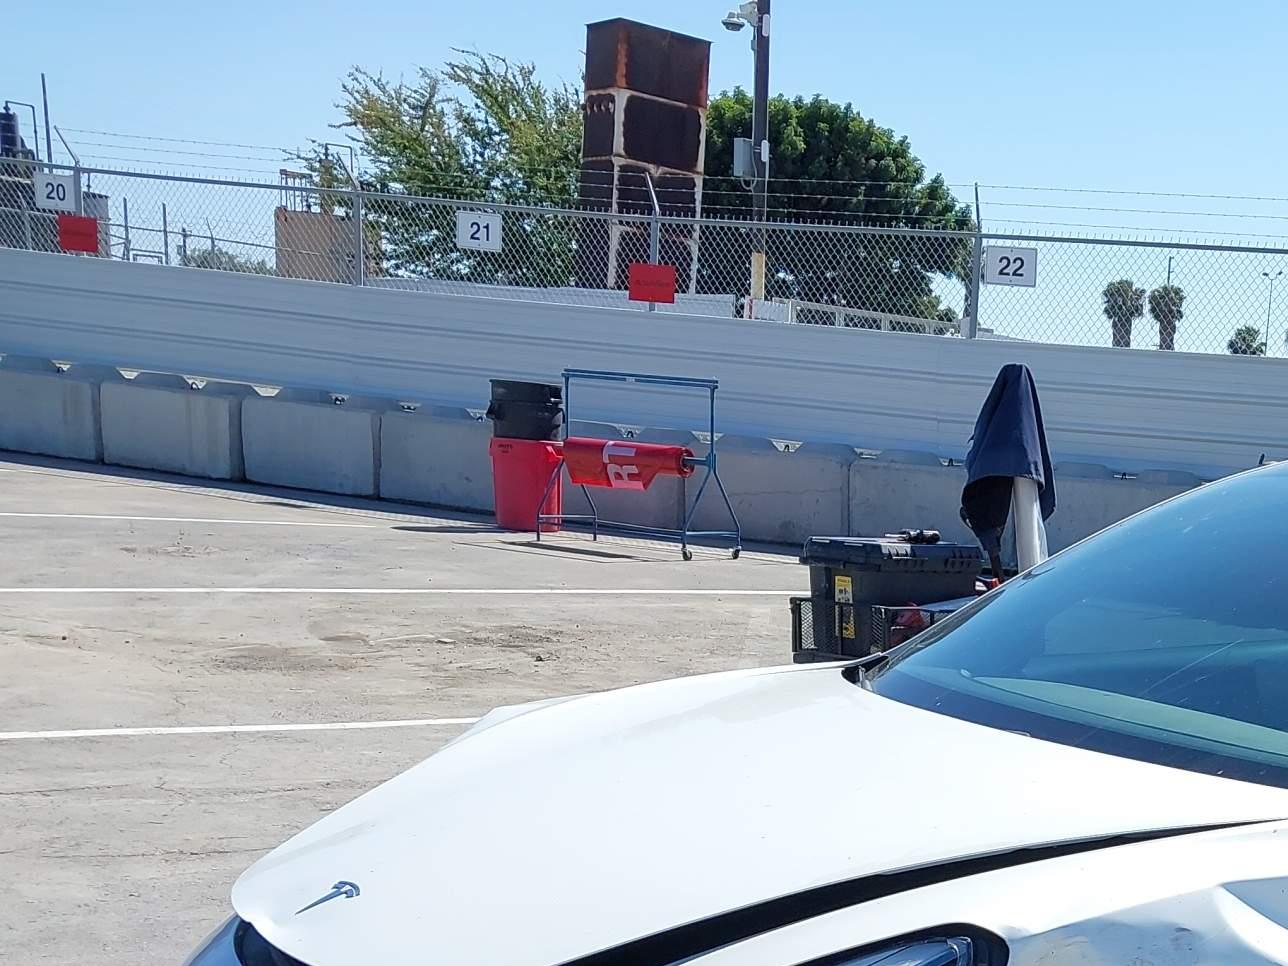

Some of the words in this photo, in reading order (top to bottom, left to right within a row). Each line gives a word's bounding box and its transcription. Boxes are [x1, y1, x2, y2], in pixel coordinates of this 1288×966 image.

[45, 181, 66, 202] 20
[469, 221, 491, 242] 21
[998, 255, 1025, 278] 22
